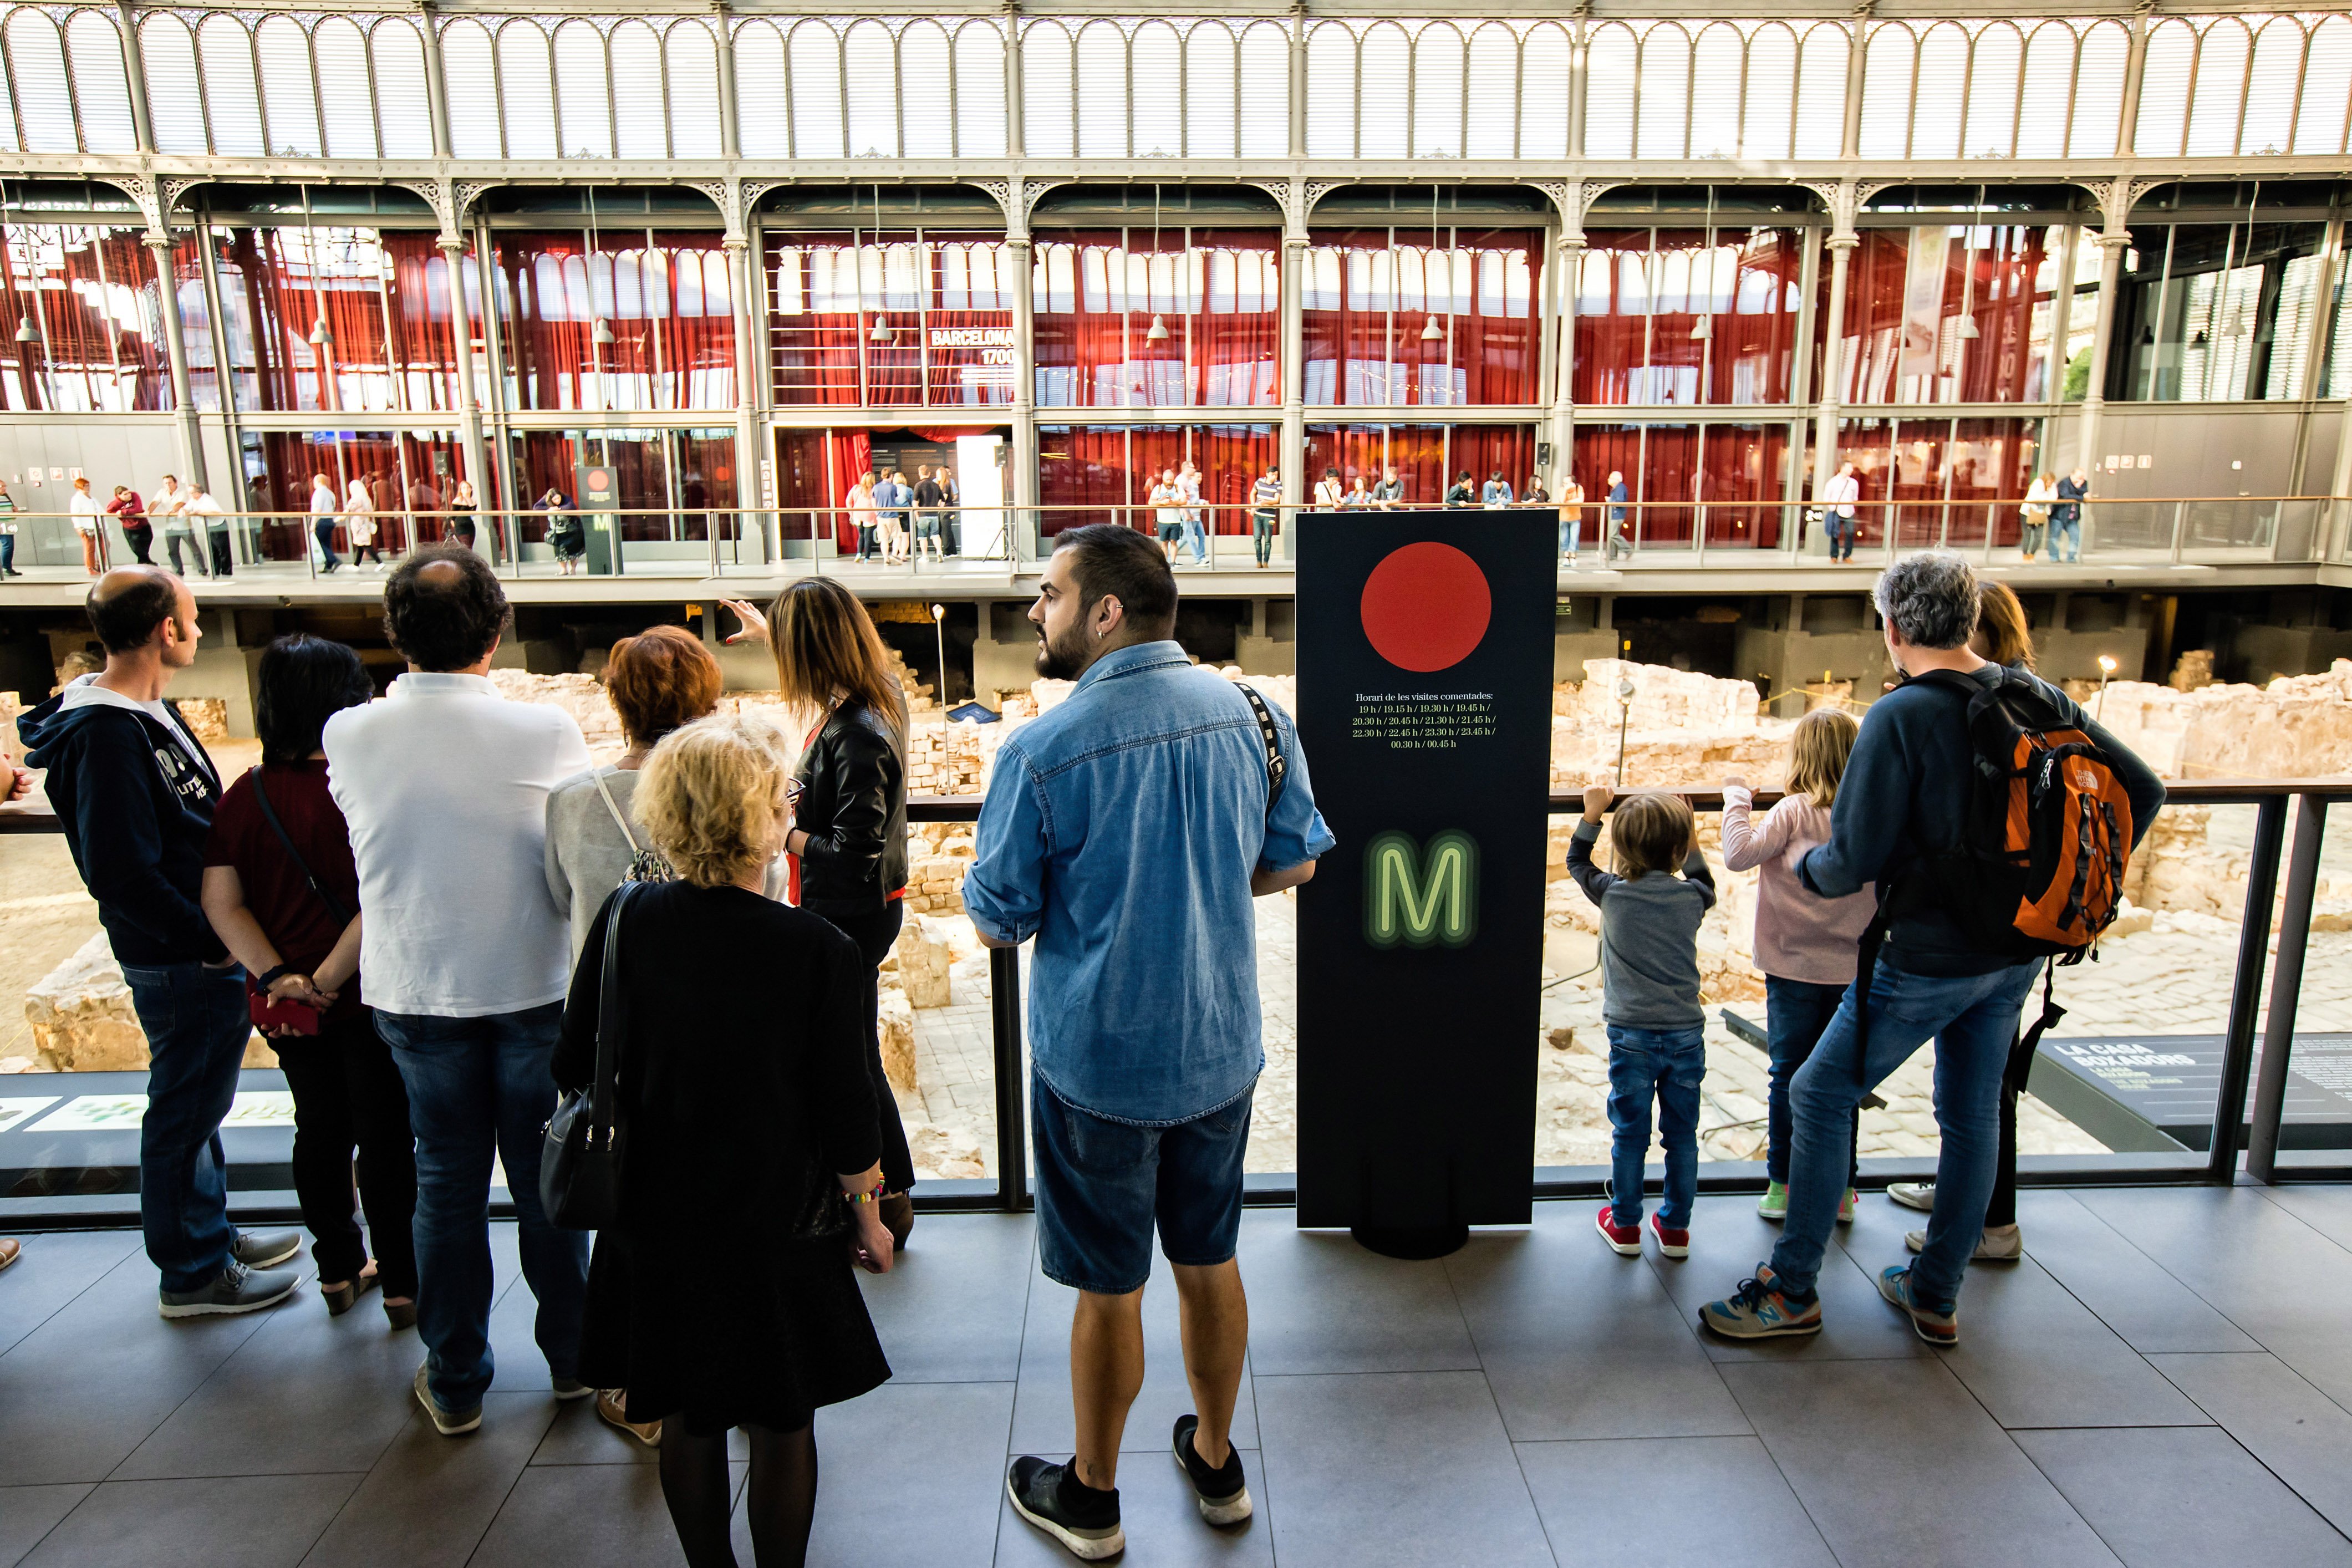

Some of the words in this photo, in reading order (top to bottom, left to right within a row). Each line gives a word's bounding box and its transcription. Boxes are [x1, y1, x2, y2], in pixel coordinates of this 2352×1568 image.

[931, 329, 1015, 347] BARCELONA
[981, 348, 1015, 365] 1700
[1356, 693, 1383, 701] Horari
[1385, 693, 1396, 701] de
[1411, 693, 1439, 701] visites
[1440, 691, 1493, 700] comentades:
[1360, 705, 1369, 714] 19
[1384, 705, 1405, 713] 19.15
[1421, 704, 1442, 712] 19.30
[1457, 704, 1478, 712] 19.45
[1352, 717, 1374, 725] 20.30
[1376, 717, 1382, 725] h
[1388, 716, 1411, 725] 20.45
[1413, 716, 1418, 725] h
[1425, 716, 1447, 724] 21.30
[1449, 716, 1454, 724] h
[1461, 715, 1483, 724] 21.45
[1485, 715, 1491, 724] h
[1352, 729, 1374, 737] 22.30
[1388, 729, 1411, 737] 22.45
[1424, 728, 1447, 736] 23.30
[1461, 727, 1483, 736] 23.45
[1391, 740, 1413, 749] 00.30
[1427, 740, 1449, 748] 00.45
[1375, 842, 1467, 938] M
[2054, 1045, 2092, 1056] LA
[2089, 1044, 2155, 1055] CASA
[2071, 1054, 2196, 1067] BOXADORS
[1756, 1305, 1783, 1327] N
